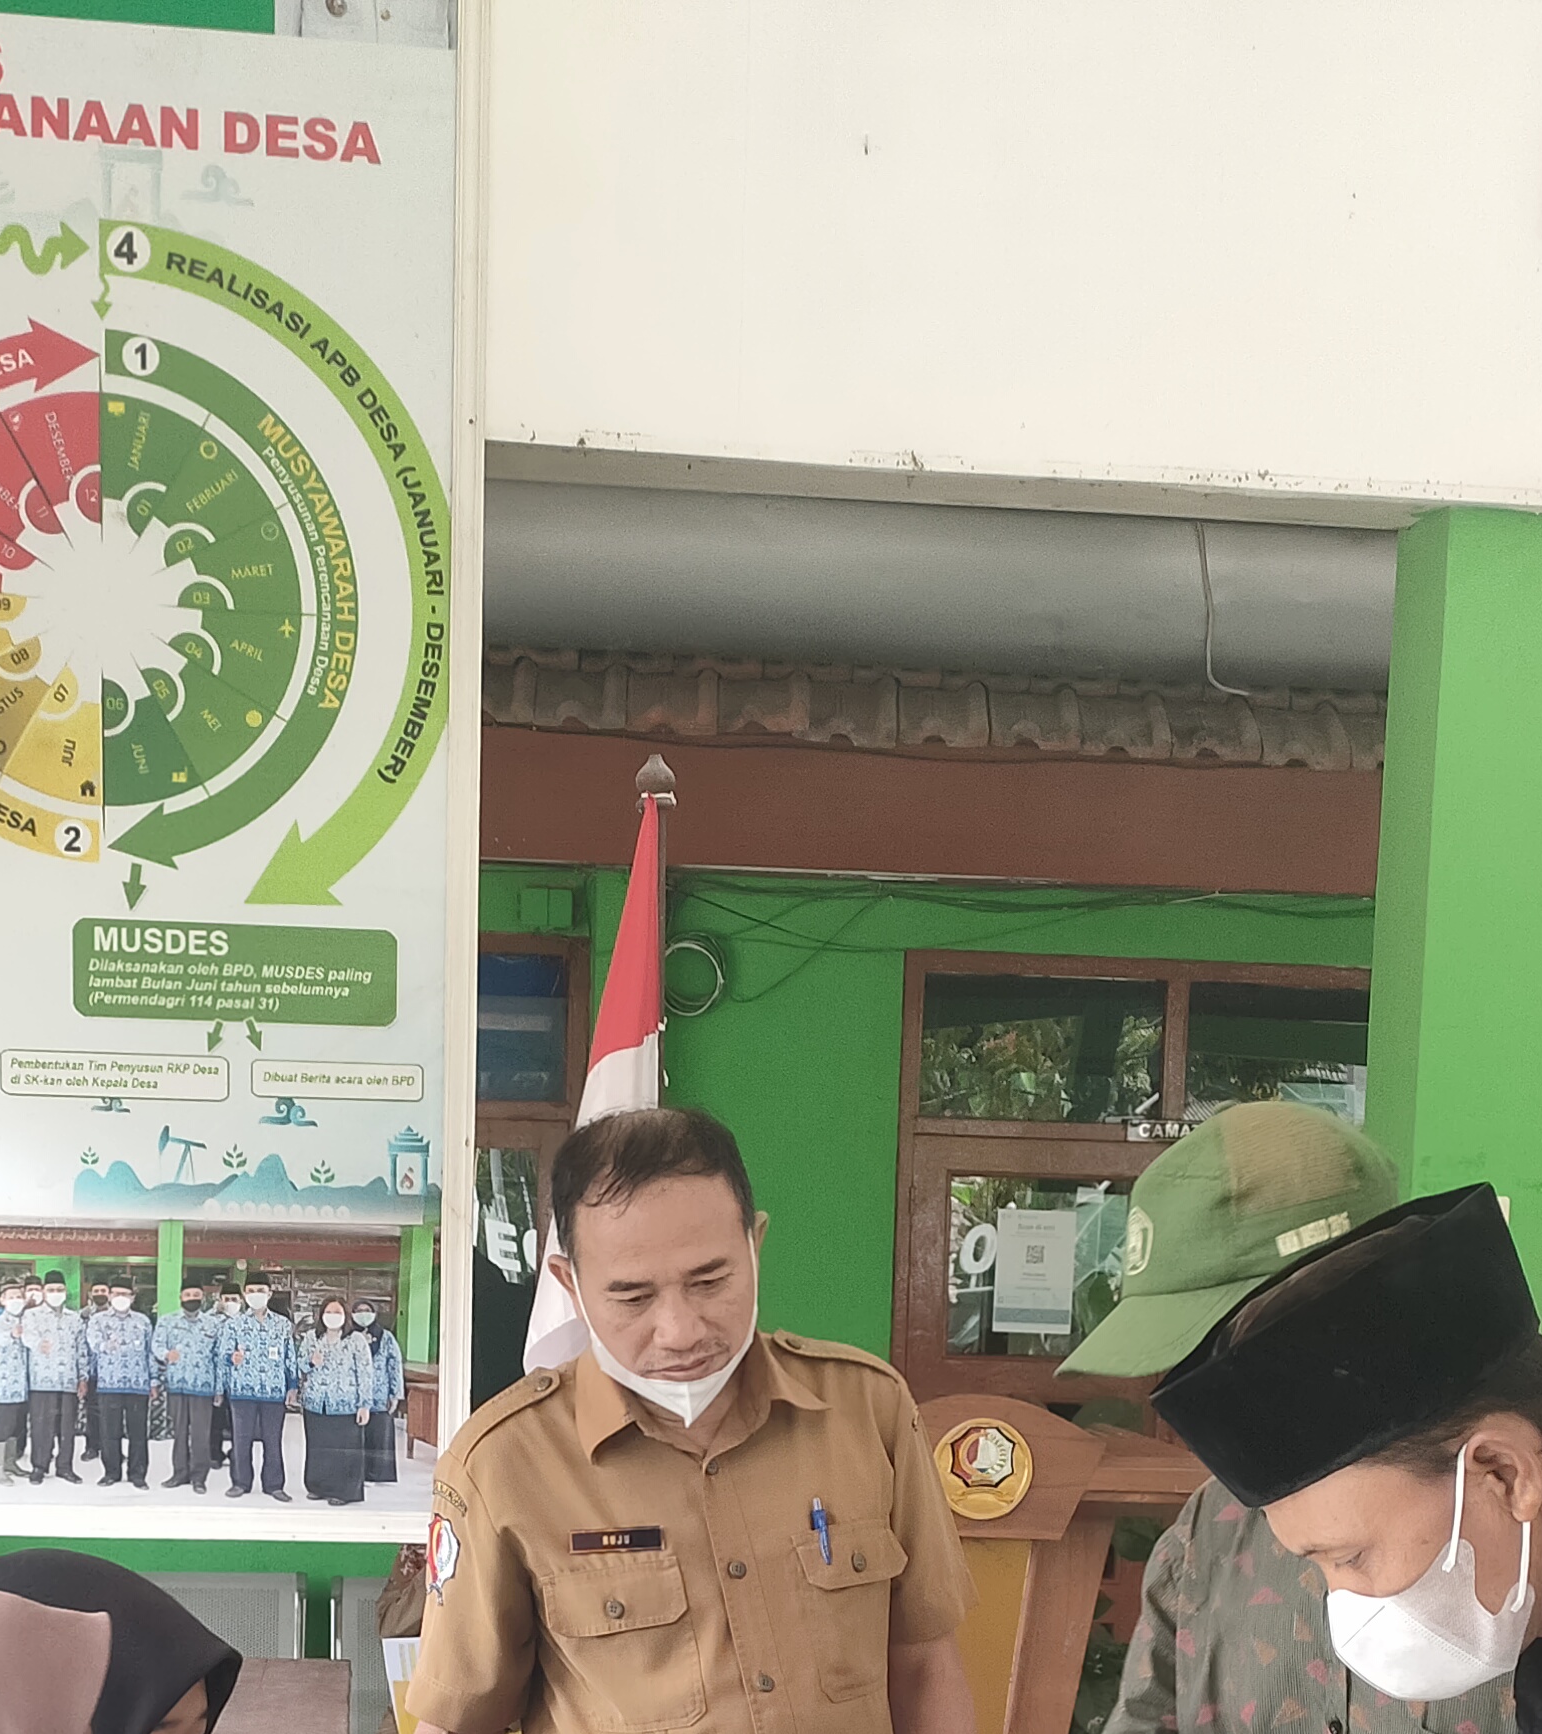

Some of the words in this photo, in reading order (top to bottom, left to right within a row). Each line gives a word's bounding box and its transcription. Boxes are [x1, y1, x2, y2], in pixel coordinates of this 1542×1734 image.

[223, 111, 381, 165] DESA
[113, 232, 137, 265] 4
[166, 252, 312, 339] REALISASI
[134, 344, 149, 371] 1
[310, 337, 362, 388] APB
[357, 387, 407, 461] DESA
[44, 411, 73, 483] DESEMBER
[186, 469, 239, 514] FEBRUARI
[262, 446, 320, 542] Penyusunan
[395, 466, 445, 596] (JANUARI
[230, 564, 275, 580] MARET
[257, 413, 356, 622] MUSYAWARAH
[318, 631, 355, 709] DESA
[230, 639, 264, 662] APRIL
[377, 622, 444, 784] DESEMBER)
[64, 826, 81, 853] 2
[93, 926, 229, 956] MUSDES
[88, 958, 184, 975] Dilaksanakan
[187, 963, 219, 977] oleh
[222, 964, 258, 979] BPD,
[261, 965, 325, 980] MUSDES
[327, 967, 373, 984] paling
[88, 975, 138, 989] lambat
[140, 977, 183, 991] Bulan
[185, 979, 217, 992] Juni
[220, 980, 261, 994] tahun
[265, 982, 350, 999] sebelumnya
[88, 991, 185, 1009] (Permendagri
[189, 994, 213, 1007] 114
[215, 995, 255, 1011] pasal
[258, 997, 280, 1012] 31)
[88, 1060, 107, 1072] Tim
[166, 1063, 190, 1074] RKP
[192, 1063, 219, 1075] Desa
[1139, 1123, 1199, 1138] CAMA
